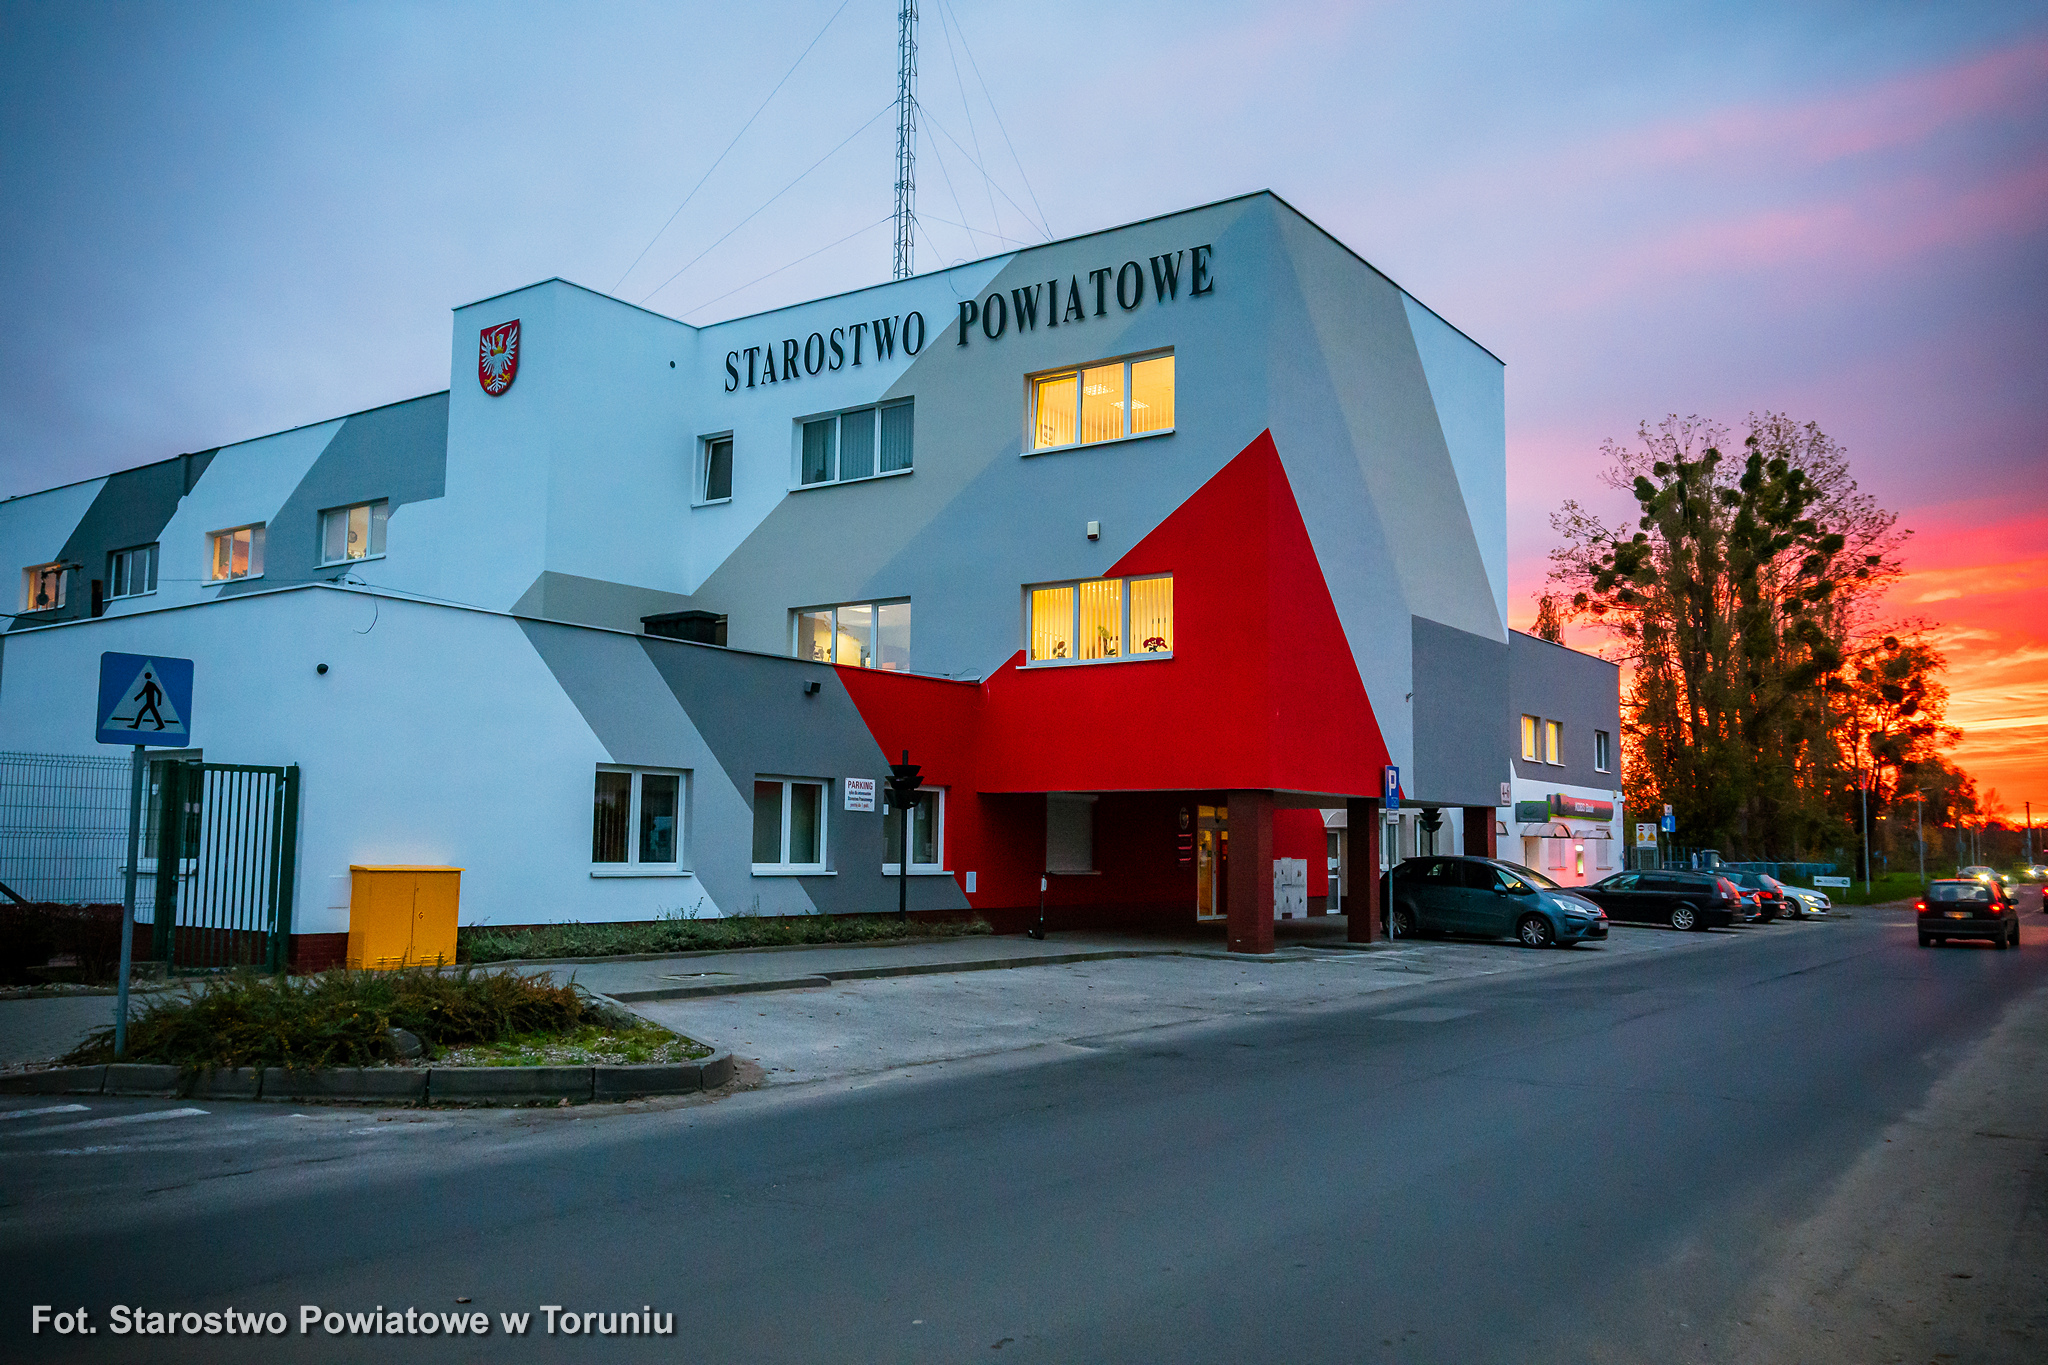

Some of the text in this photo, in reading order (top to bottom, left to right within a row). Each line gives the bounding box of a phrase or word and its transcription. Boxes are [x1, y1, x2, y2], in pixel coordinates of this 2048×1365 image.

[724, 243, 1215, 393] STAROSTWO POWIATOWE
[847, 780, 873, 790] PARKING
[1388, 769, 1397, 797] P
